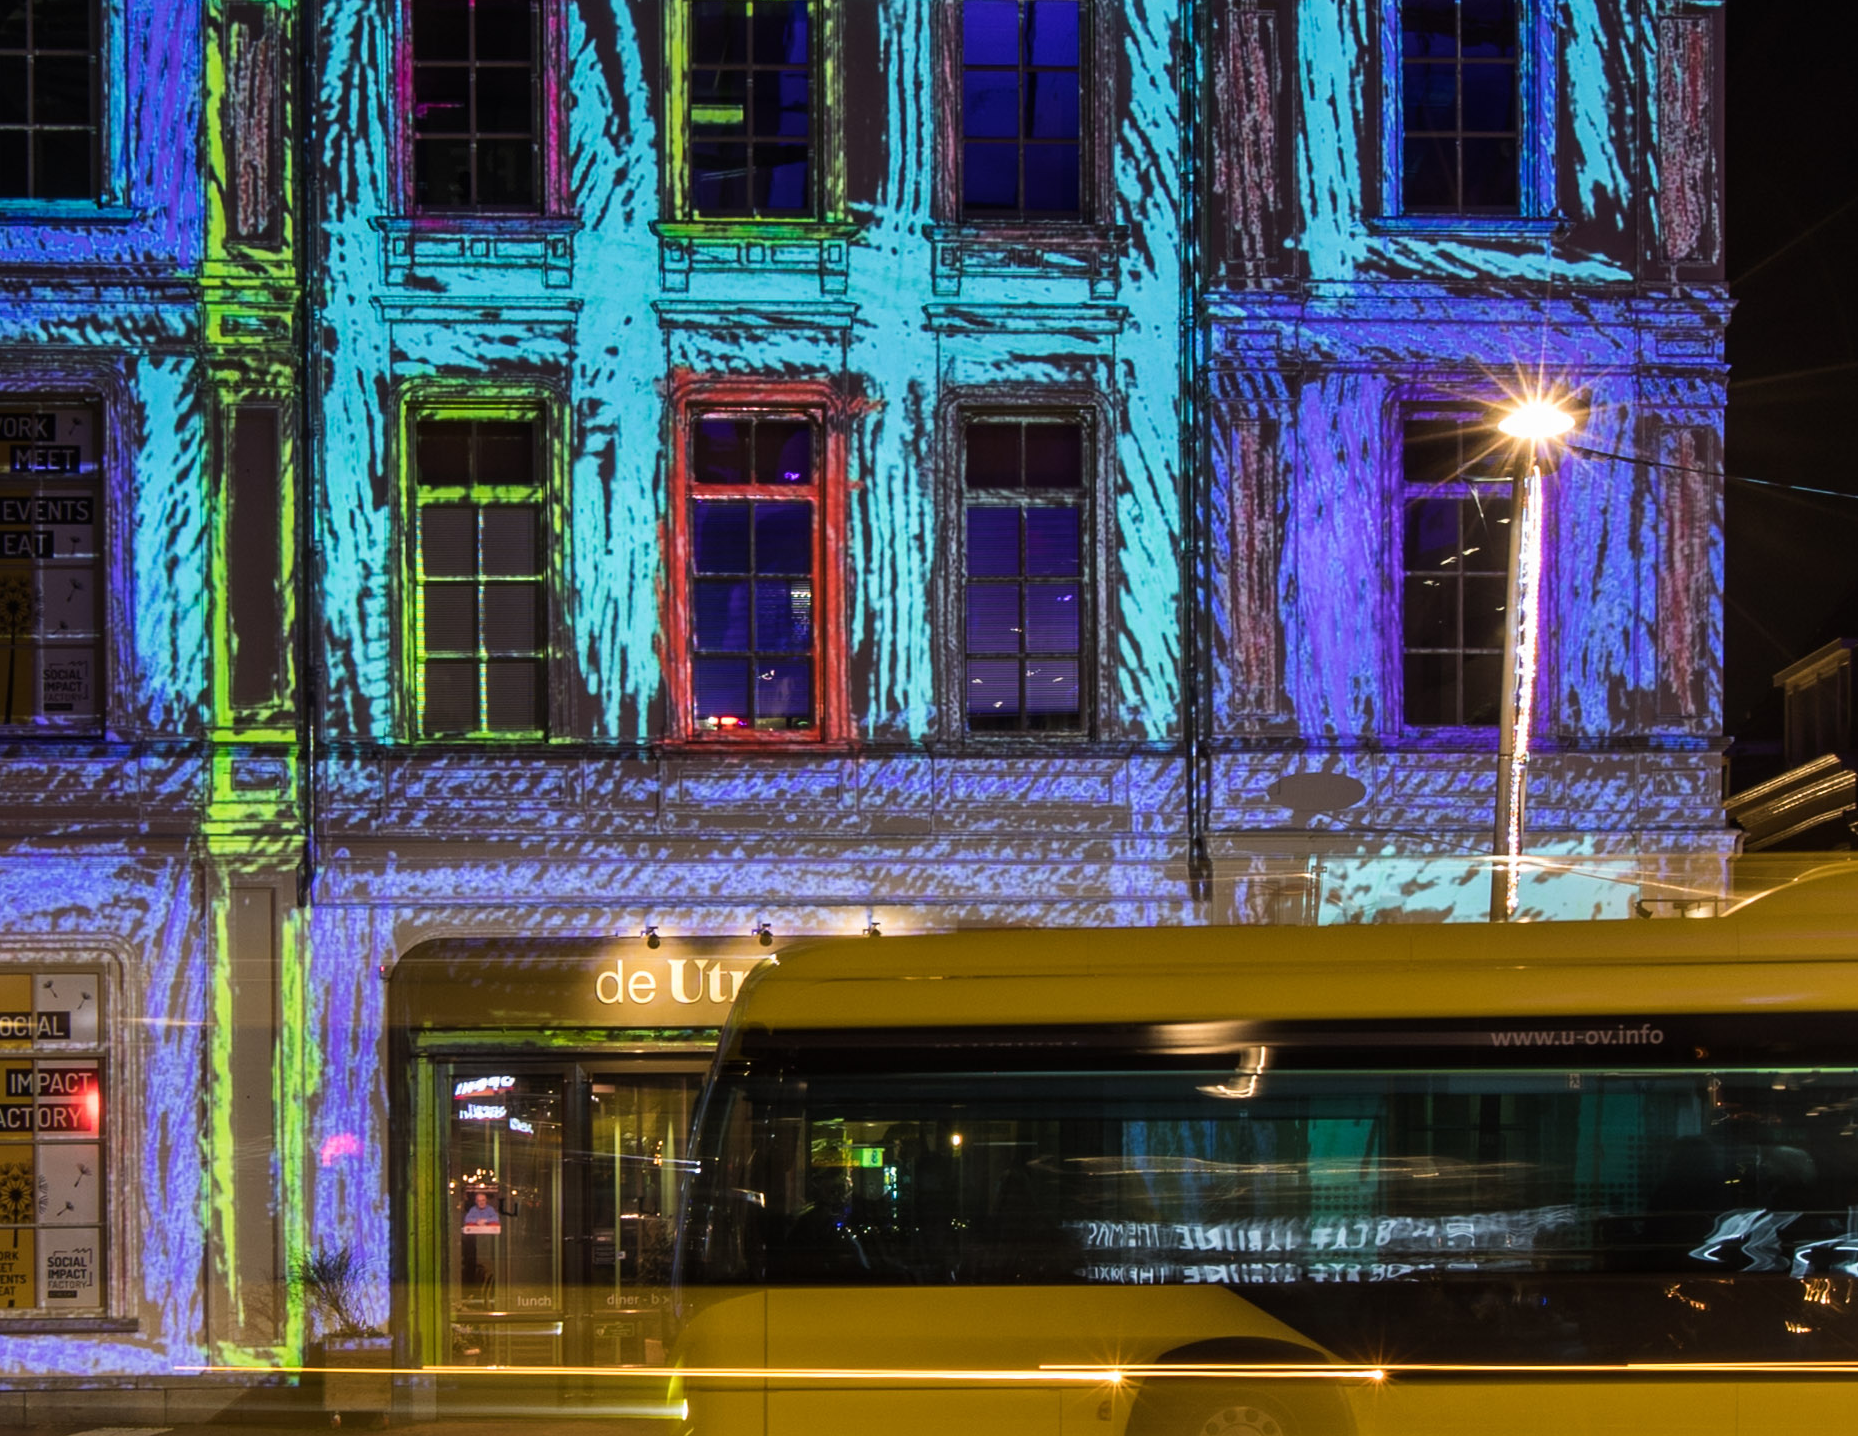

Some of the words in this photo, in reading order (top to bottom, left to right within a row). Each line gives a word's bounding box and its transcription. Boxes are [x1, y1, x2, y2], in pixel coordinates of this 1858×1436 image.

[15, 449, 75, 470] MEET
[2, 500, 89, 522] EVENTS
[4, 534, 48, 556] EAT
[44, 669, 83, 680] SOCIAL
[596, 959, 656, 1004] de
[1491, 1023, 1664, 1047] www.u-ov.info
[11, 1072, 92, 1094] IMPACT
[47, 1256, 87, 1268] SOCIAL
[48, 1268, 87, 1279] IMPACT
[48, 1280, 87, 1289] FACTORY
[517, 1295, 552, 1307] lunch
[606, 1294, 639, 1308] diner
